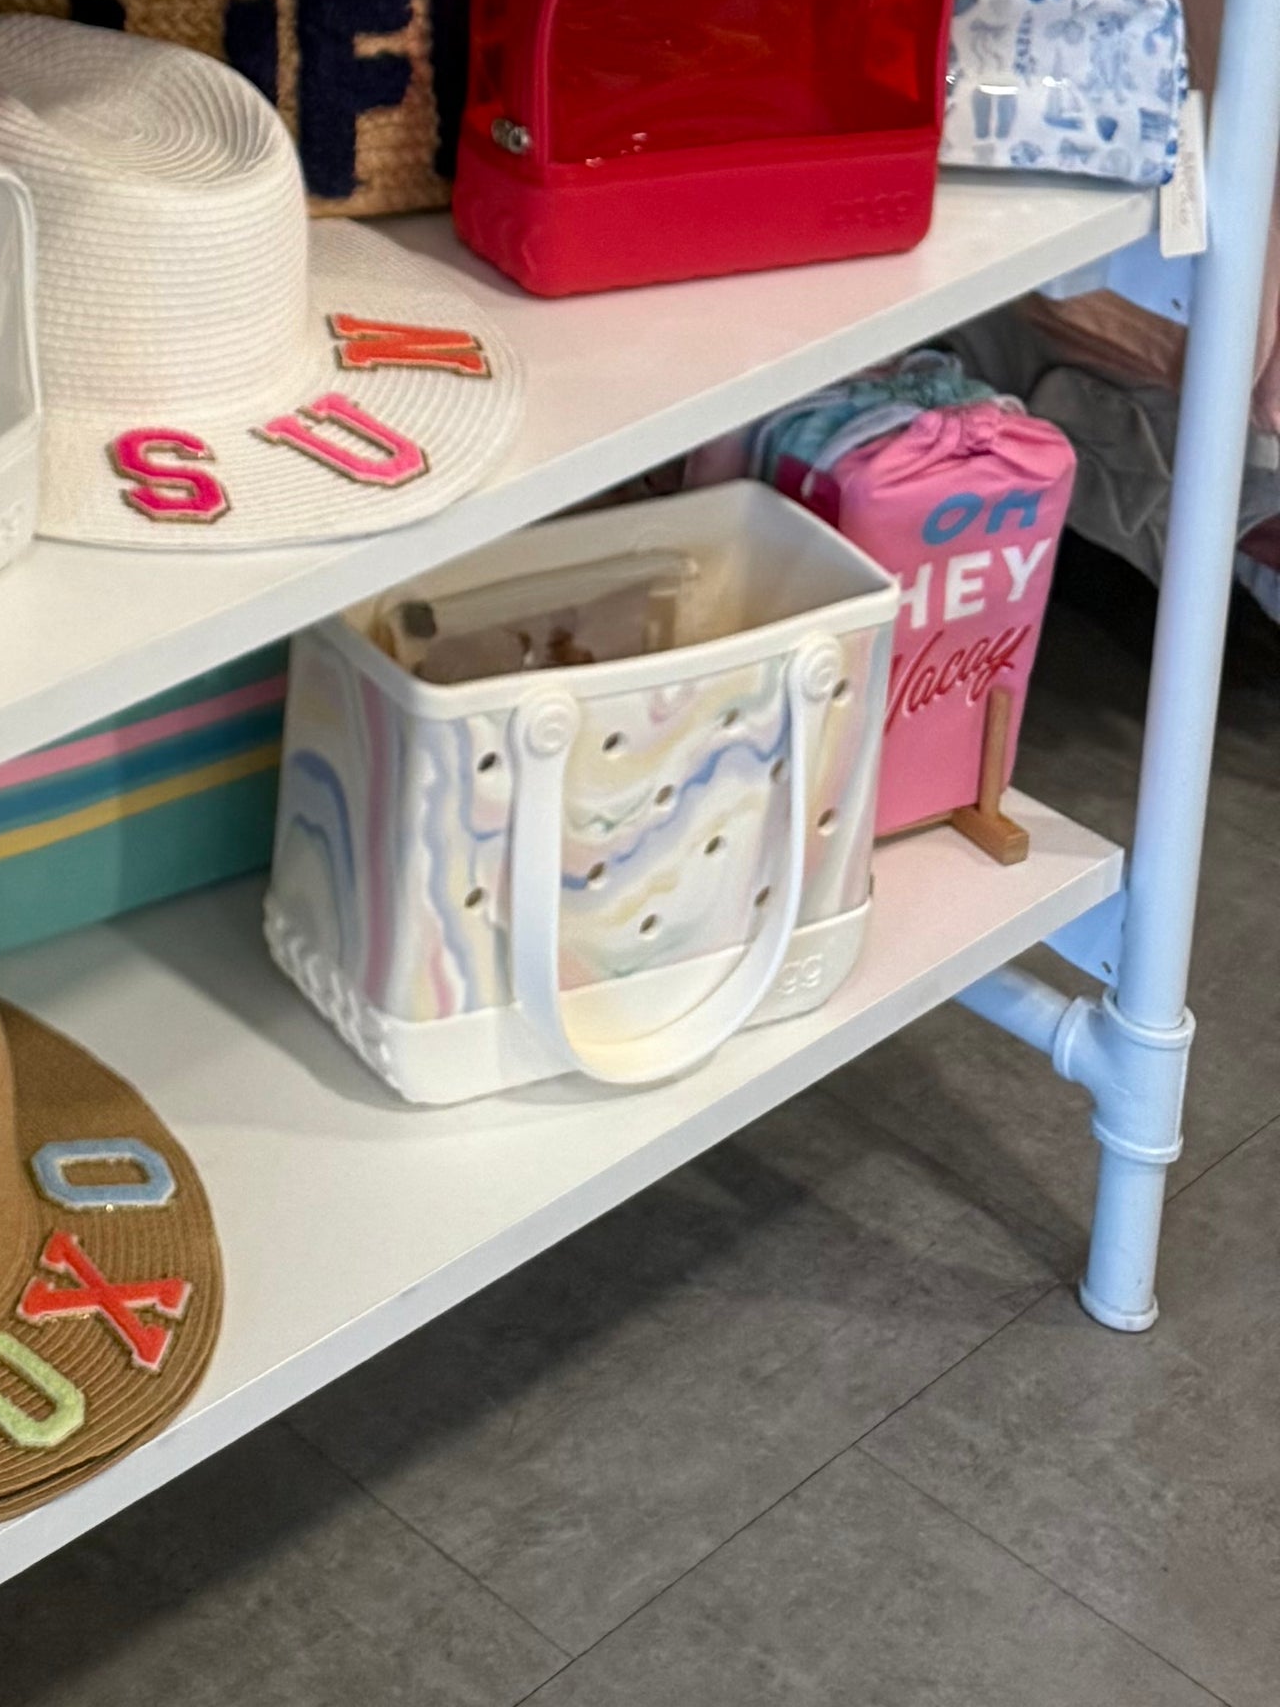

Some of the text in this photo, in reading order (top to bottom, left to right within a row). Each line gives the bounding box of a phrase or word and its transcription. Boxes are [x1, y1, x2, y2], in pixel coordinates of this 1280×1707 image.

[107, 312, 492, 525] SUN
[922, 487, 1045, 547] OH
[893, 535, 1054, 632] HEY
[883, 617, 1033, 737] Vacay
